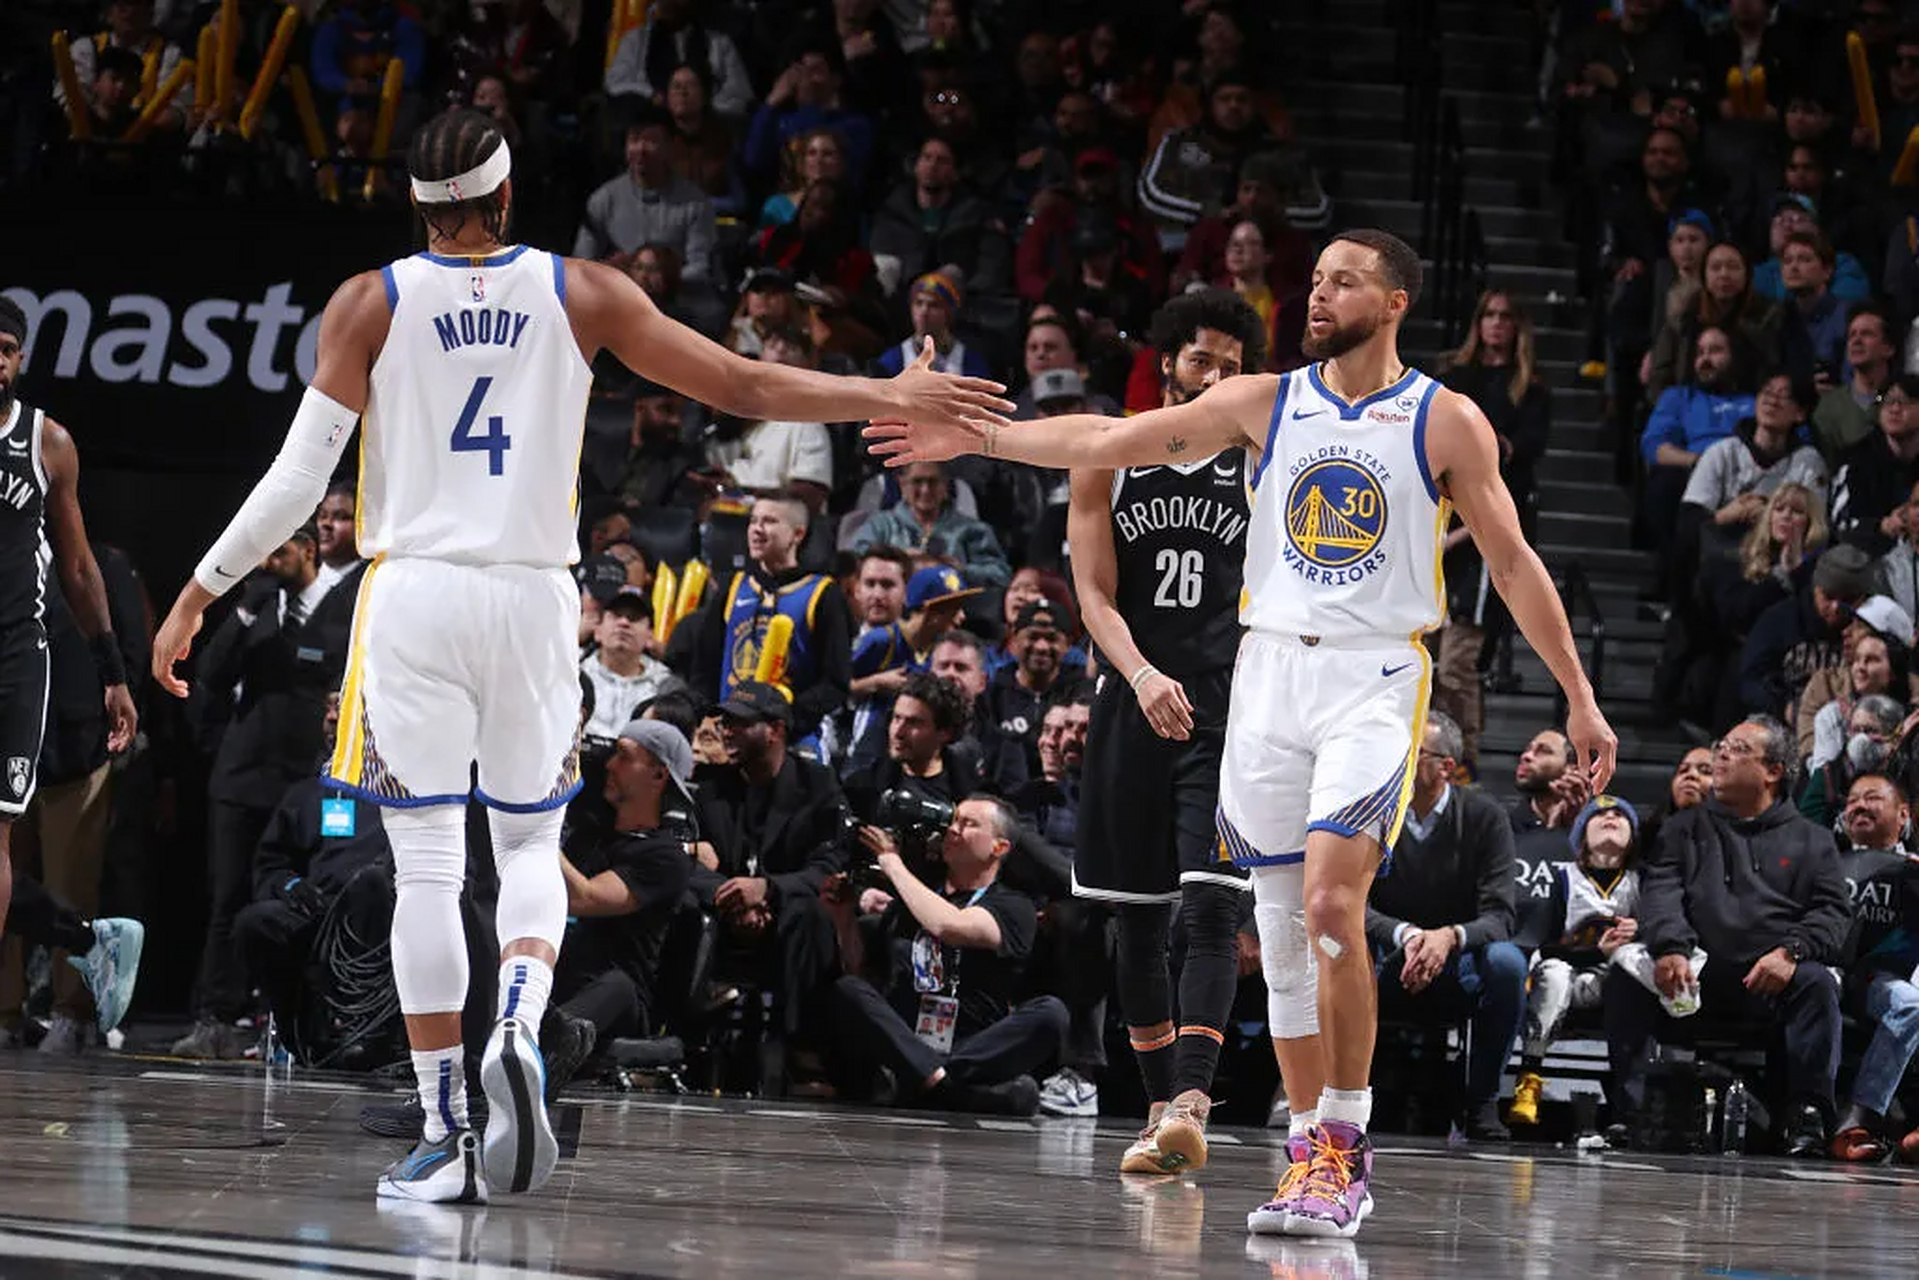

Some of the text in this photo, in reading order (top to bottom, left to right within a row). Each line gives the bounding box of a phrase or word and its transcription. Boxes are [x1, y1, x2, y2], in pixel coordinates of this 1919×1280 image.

[433, 308, 530, 352] MOODY
[450, 376, 511, 476] 4
[1289, 445, 1392, 484] GOLDEN STATE
[0, 469, 35, 511] YN
[1340, 486, 1376, 519] 30
[1115, 495, 1247, 546] BROOKLYN
[1154, 548, 1204, 609] 26
[1282, 540, 1387, 586] WARRIORS
